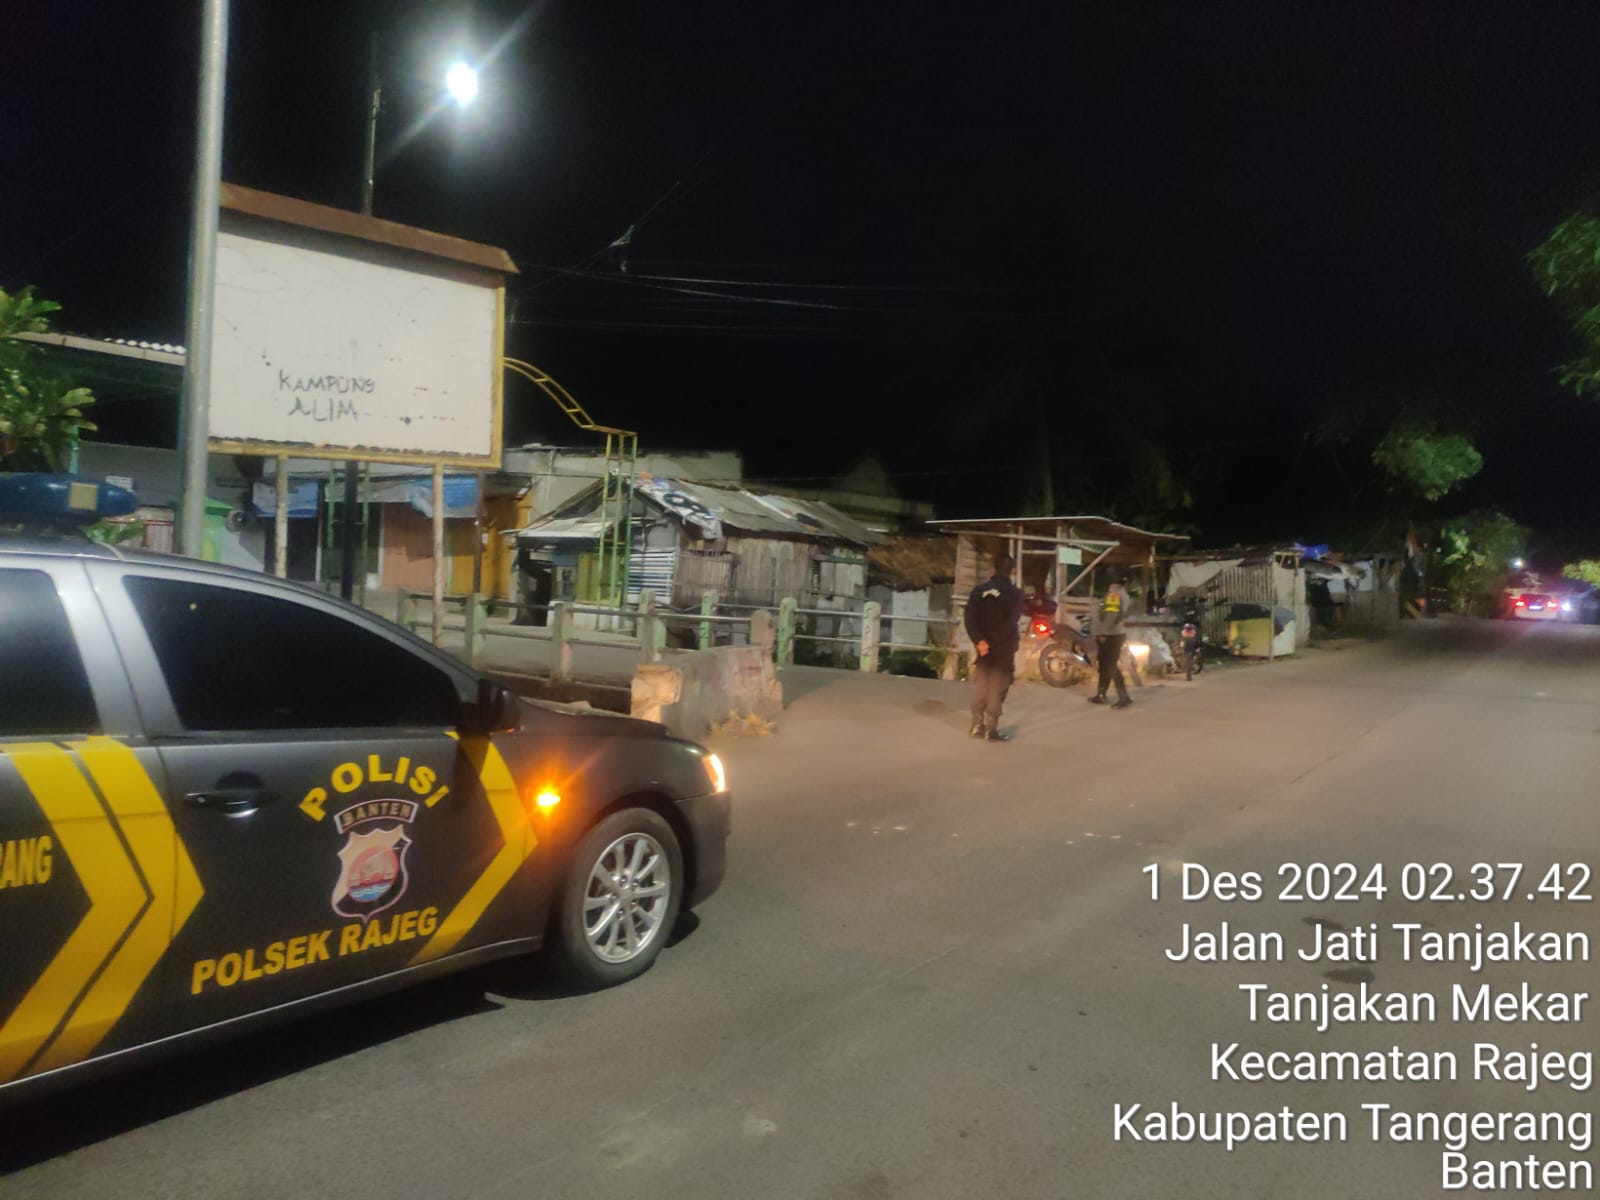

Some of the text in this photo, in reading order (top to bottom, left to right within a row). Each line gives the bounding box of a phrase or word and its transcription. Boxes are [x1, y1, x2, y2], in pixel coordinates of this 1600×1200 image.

[287, 397, 359, 423] ALIM
[298, 753, 450, 822] POLISI
[342, 801, 413, 827] BANTEN
[191, 906, 439, 996] POLSEK RAJEG
